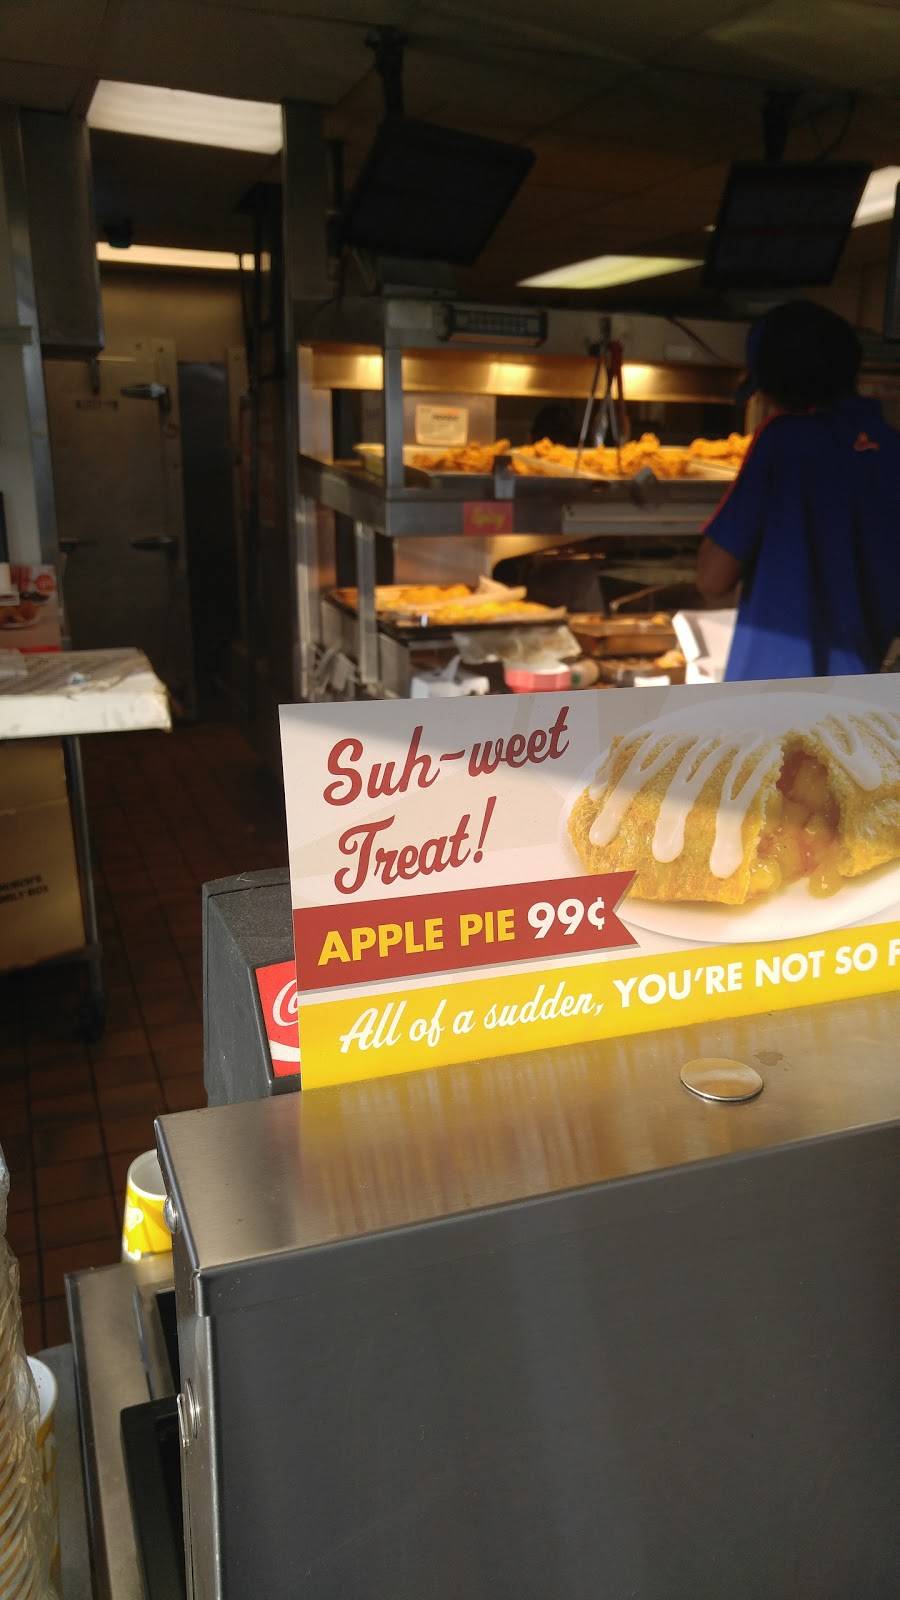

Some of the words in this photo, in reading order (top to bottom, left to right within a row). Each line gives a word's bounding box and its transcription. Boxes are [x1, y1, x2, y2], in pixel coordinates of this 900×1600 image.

[323, 706, 570, 806] Suh-weet
[334, 796, 497, 894] Treat!
[317, 917, 444, 966] APPLE
[459, 909, 515, 946] PIE
[527, 896, 606, 939] 99¢
[339, 1000, 407, 1053] All
[408, 999, 447, 1047] of
[452, 1008, 476, 1034] a
[483, 980, 604, 1029] sudden,
[613, 962, 743, 1008] YOU'RE
[755, 950, 824, 987] NOT
[835, 942, 878, 975] SO
